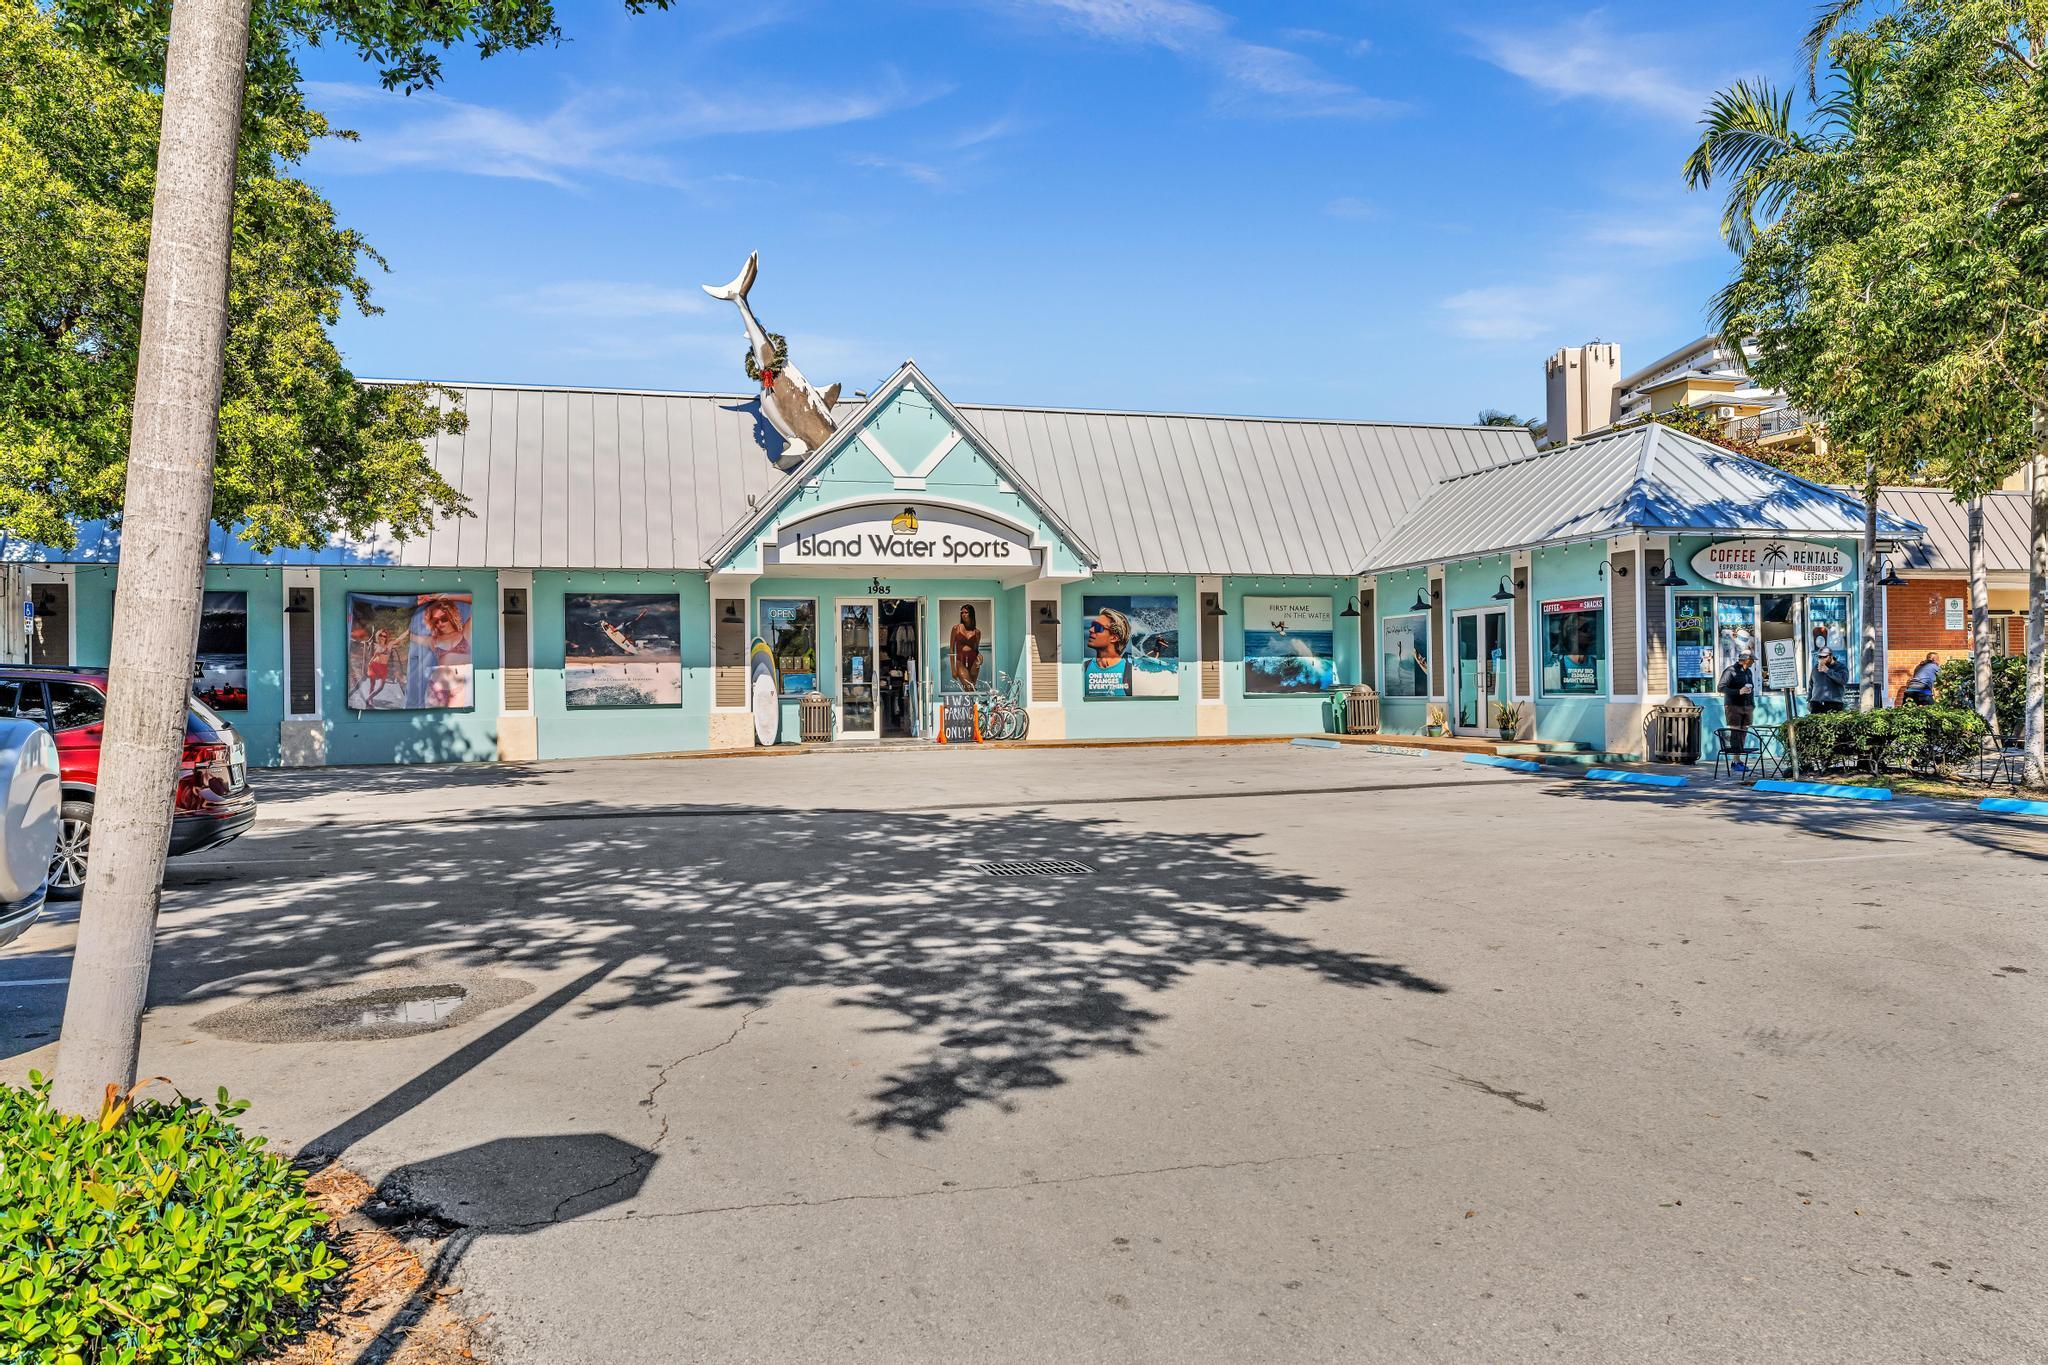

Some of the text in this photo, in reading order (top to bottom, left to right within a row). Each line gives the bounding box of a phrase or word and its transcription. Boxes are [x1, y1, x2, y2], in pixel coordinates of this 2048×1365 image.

[796, 533, 1010, 563] Island Water Sports
[1710, 549, 1756, 563] COFFEE
[1793, 551, 1839, 564] RENTALS
[1715, 571, 1752, 579] COLD BREW
[1803, 573, 1829, 581] LESSONS
[867, 585, 891, 594] 1985
[1543, 600, 1603, 613] COFFEE SNACKS
[770, 609, 795, 618] OPEN
[944, 706, 974, 720] PARKING
[945, 726, 972, 739] ONLY!
